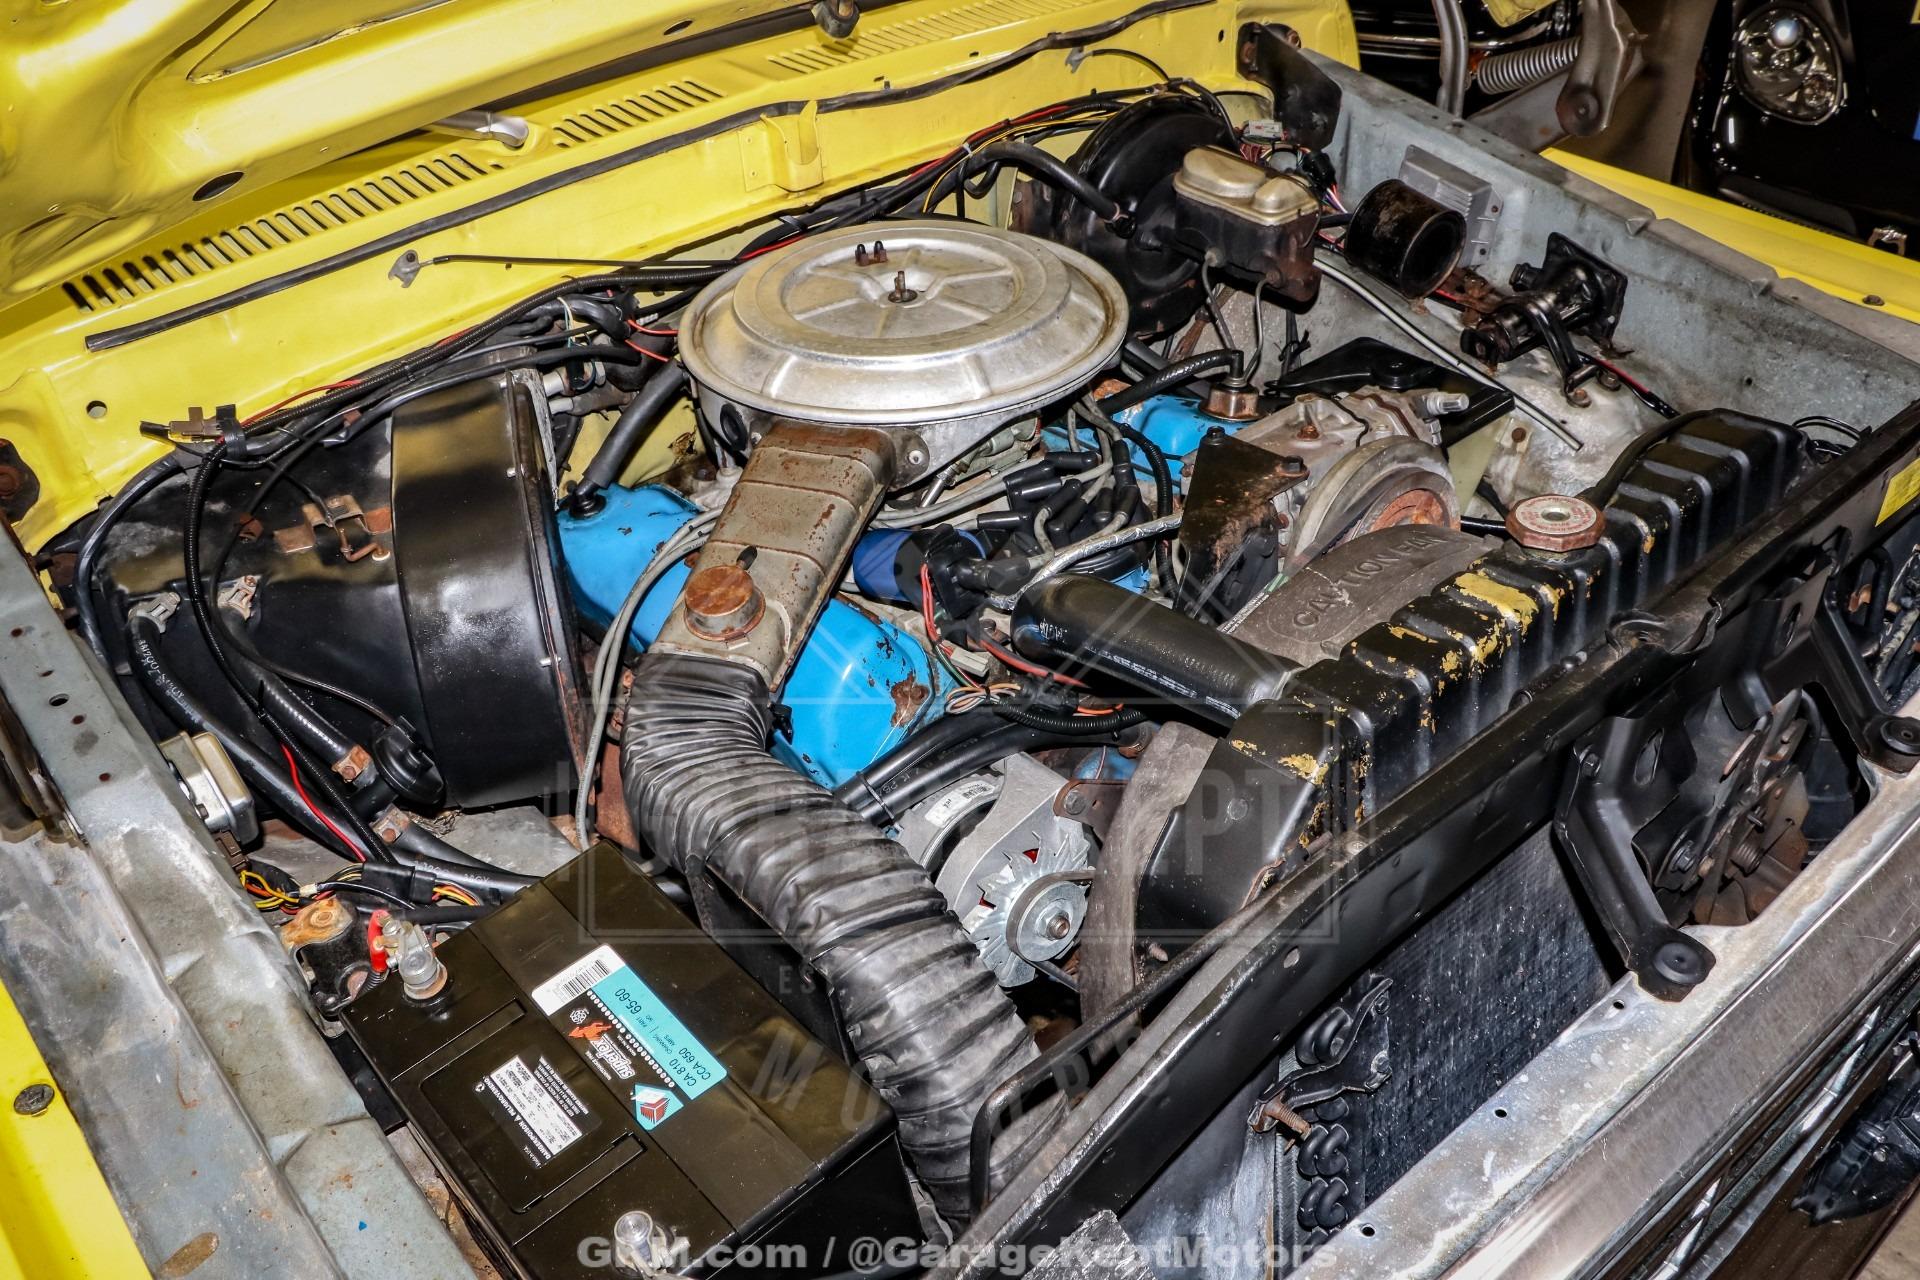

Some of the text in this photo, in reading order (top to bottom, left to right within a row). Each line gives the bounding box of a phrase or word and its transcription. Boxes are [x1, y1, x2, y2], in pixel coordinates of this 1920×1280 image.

[614, 987, 643, 1015] 65-60
[668, 1057, 696, 1087] CA 810
[678, 1046, 711, 1081] CCA 650
